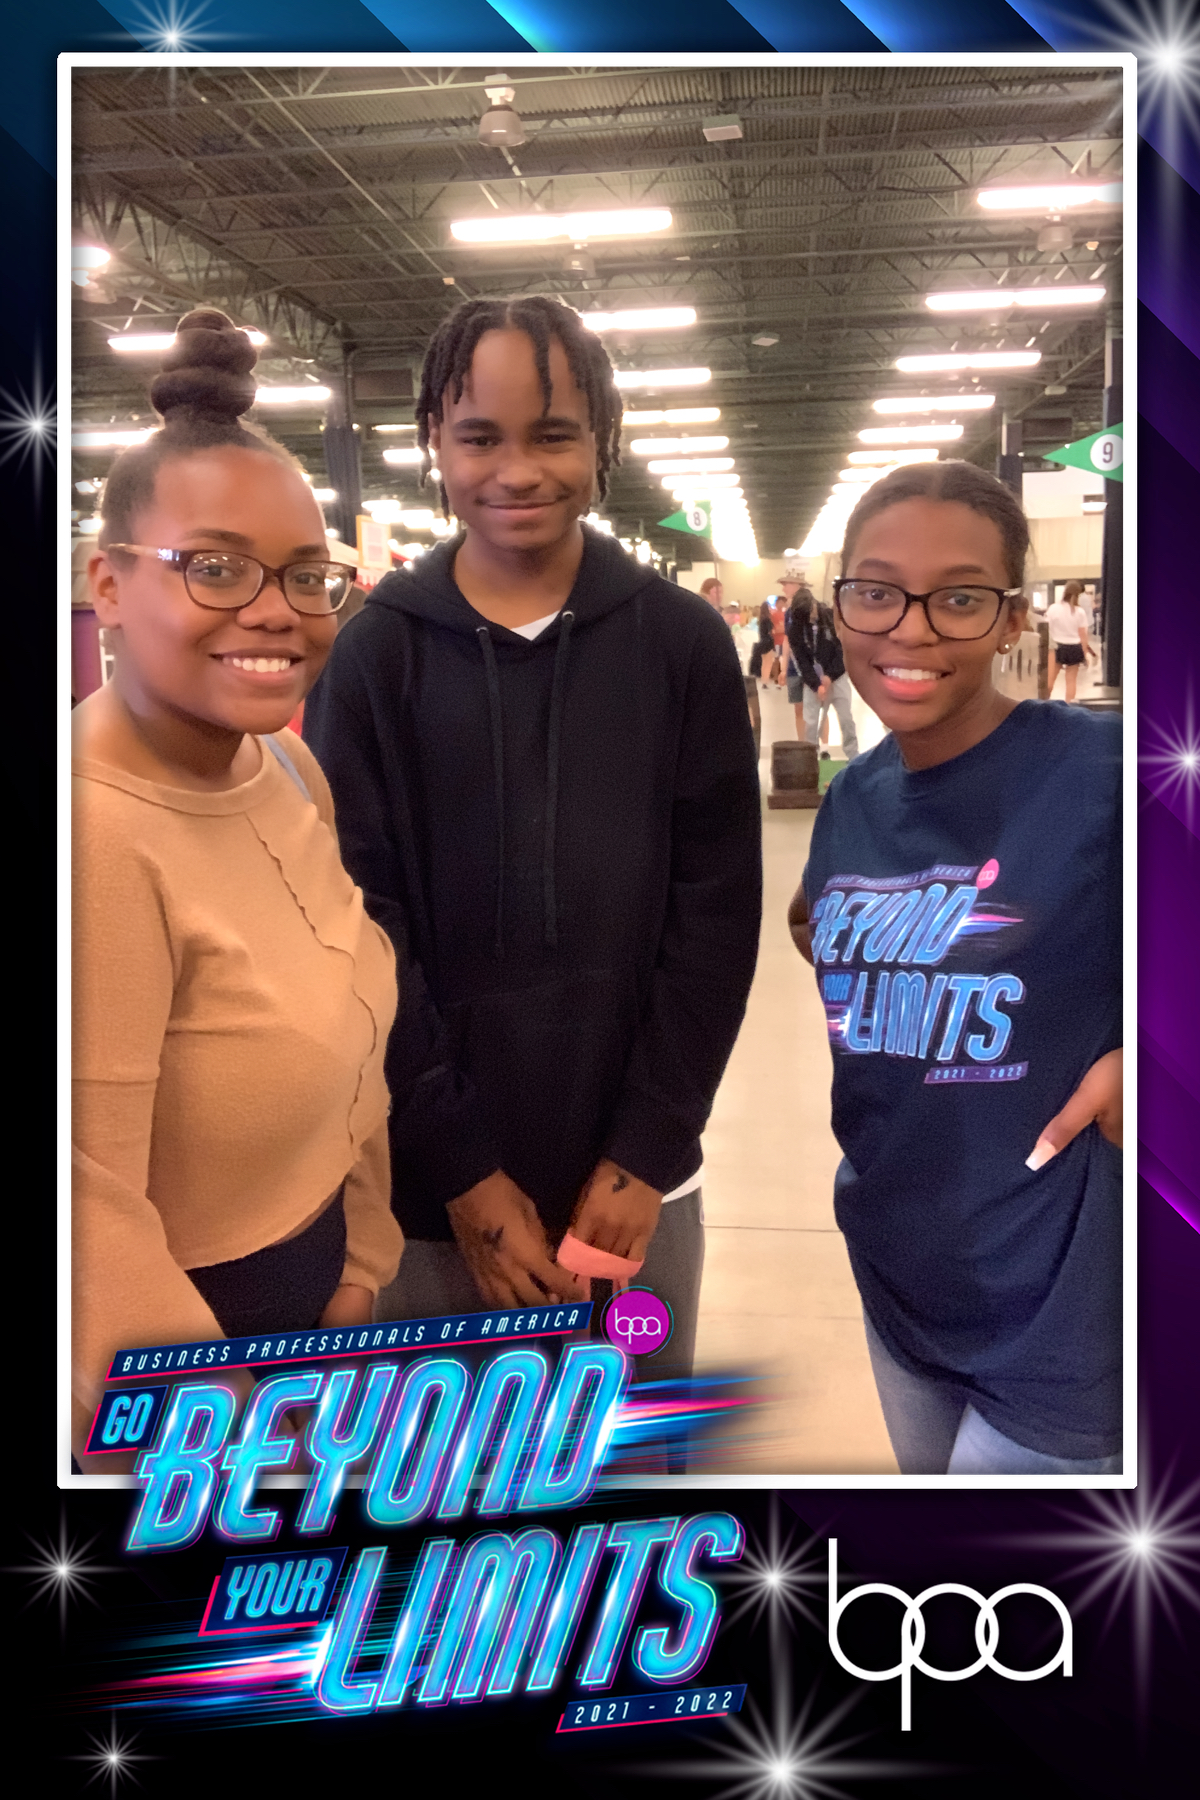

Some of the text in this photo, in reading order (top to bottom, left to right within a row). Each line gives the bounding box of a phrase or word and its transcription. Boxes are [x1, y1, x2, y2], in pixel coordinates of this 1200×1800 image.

[1102, 441, 1114, 464] 9
[692, 511, 702, 527] 8
[811, 883, 979, 964] BEYOND
[847, 971, 1026, 1062] LIMITS
[934, 1068, 966, 1080] 2021
[989, 1065, 1022, 1078] 2022
